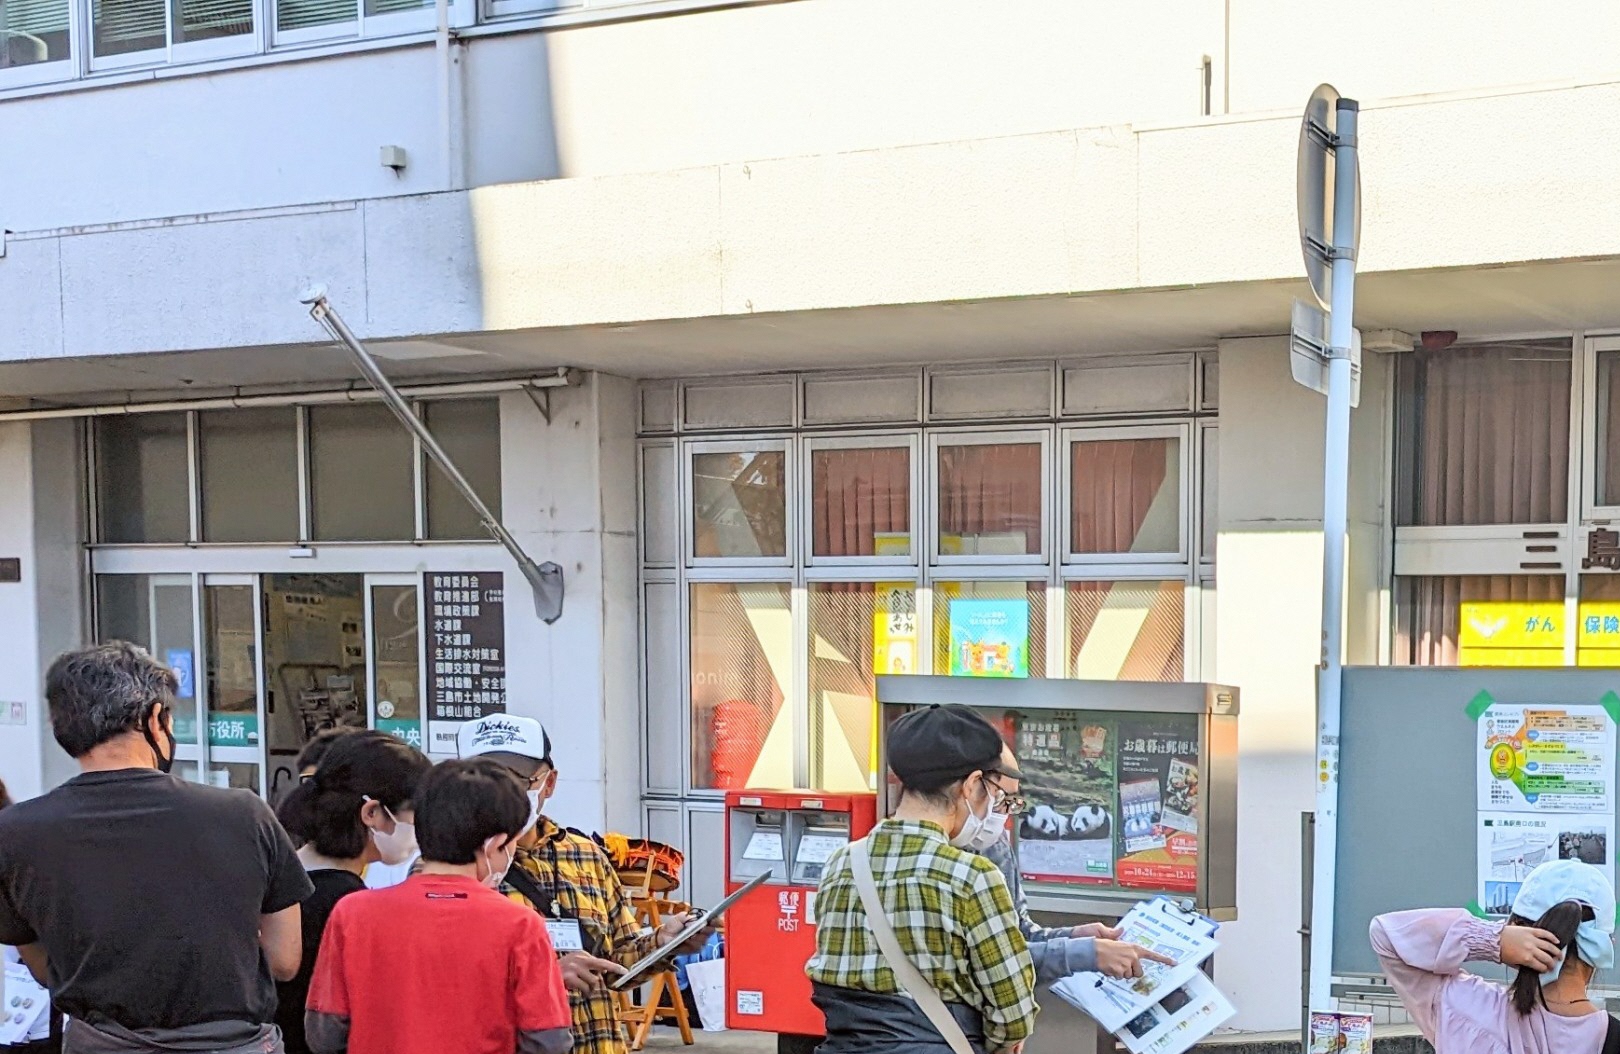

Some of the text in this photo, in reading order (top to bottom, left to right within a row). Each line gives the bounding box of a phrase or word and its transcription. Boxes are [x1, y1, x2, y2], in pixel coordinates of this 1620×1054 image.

[433, 576, 480, 588] 教育委員会
[434, 619, 462, 631] 水道課
[1525, 615, 1556, 633] がん
[434, 633, 472, 646] 下水道課
[434, 648, 500, 661] 生活排水対策室
[435, 663, 481, 675] 国際交流室
[475, 720, 521, 735] Dickies
[778, 892, 799, 907] 郵便
[778, 918, 799, 932] POST
